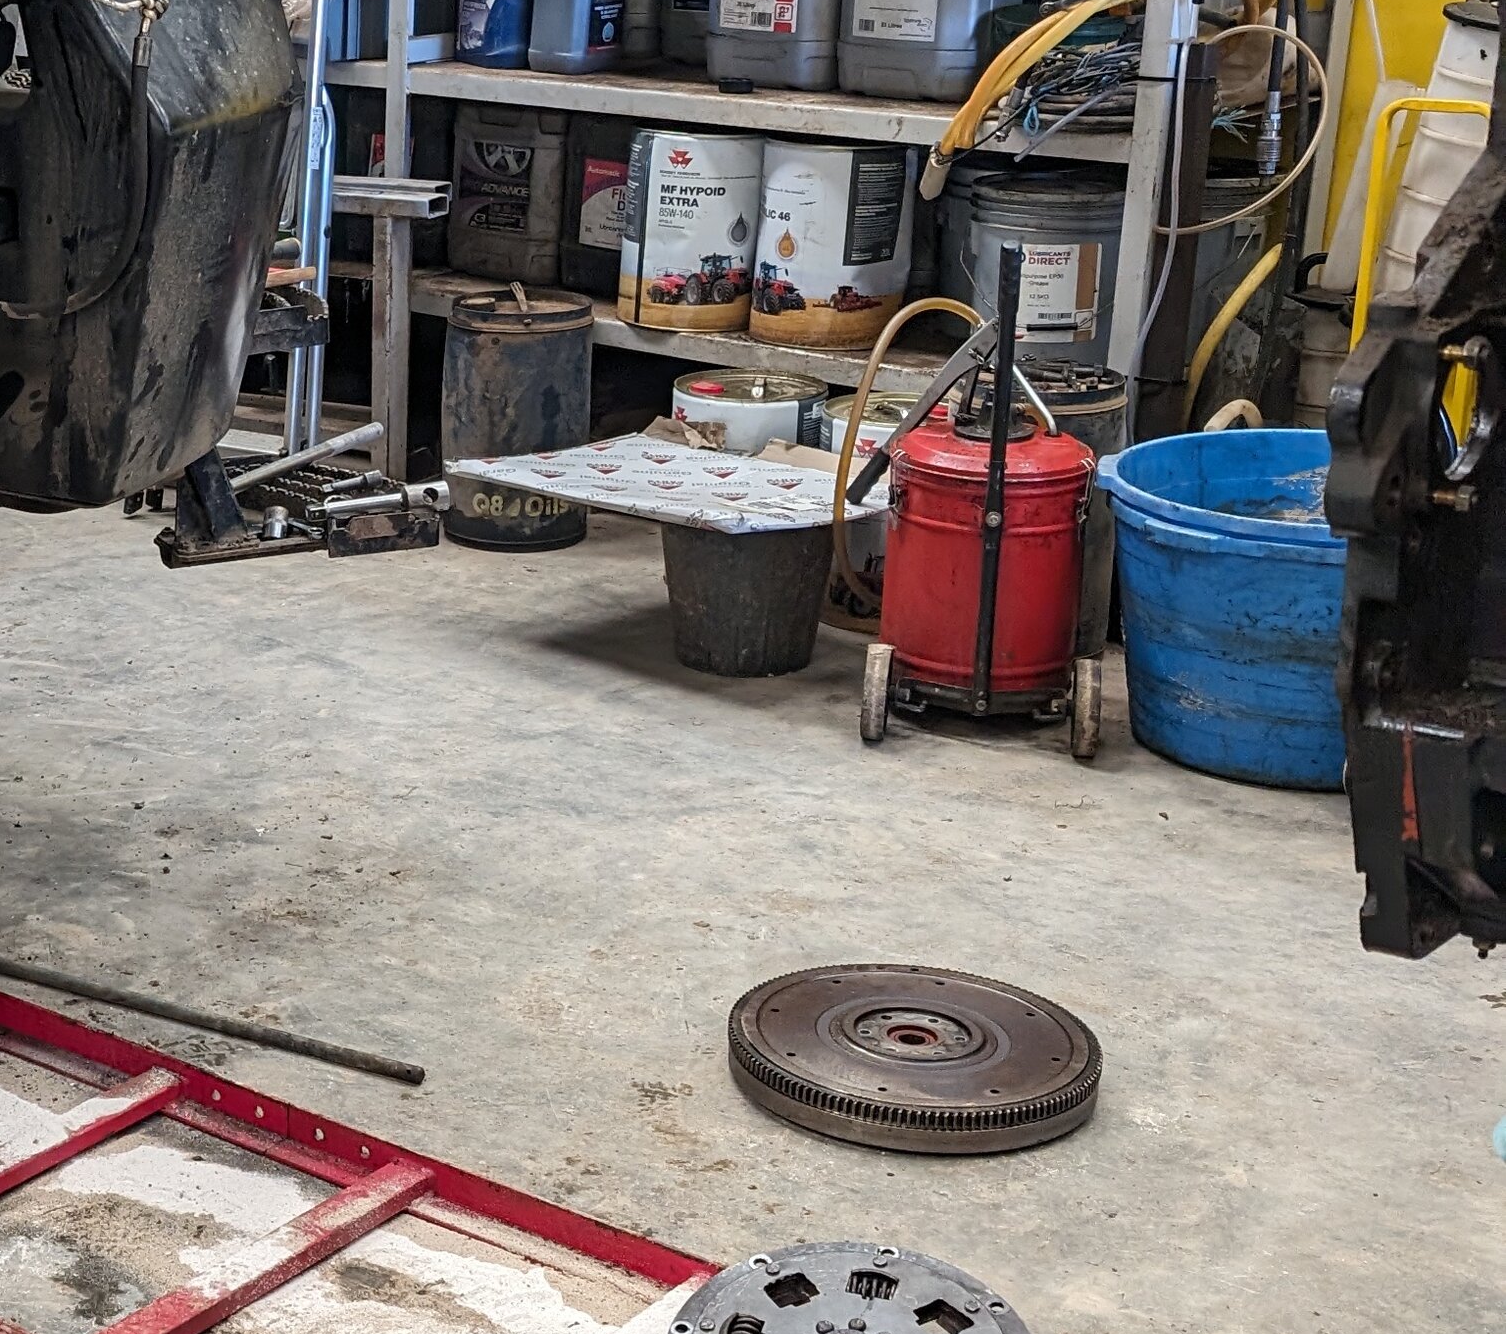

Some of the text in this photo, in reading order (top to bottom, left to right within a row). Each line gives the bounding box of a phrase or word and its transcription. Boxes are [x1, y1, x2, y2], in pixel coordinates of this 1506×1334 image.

[587, 165, 621, 178] Automatic
[481, 183, 529, 197] ADVANCE
[660, 184, 726, 197] MF HYPOID
[660, 196, 699, 208] EXTRA
[658, 207, 694, 219] 85W-140
[777, 211, 791, 222] 46
[1028, 257, 1071, 265] DIRECT
[472, 492, 569, 517] Q8 Oils
